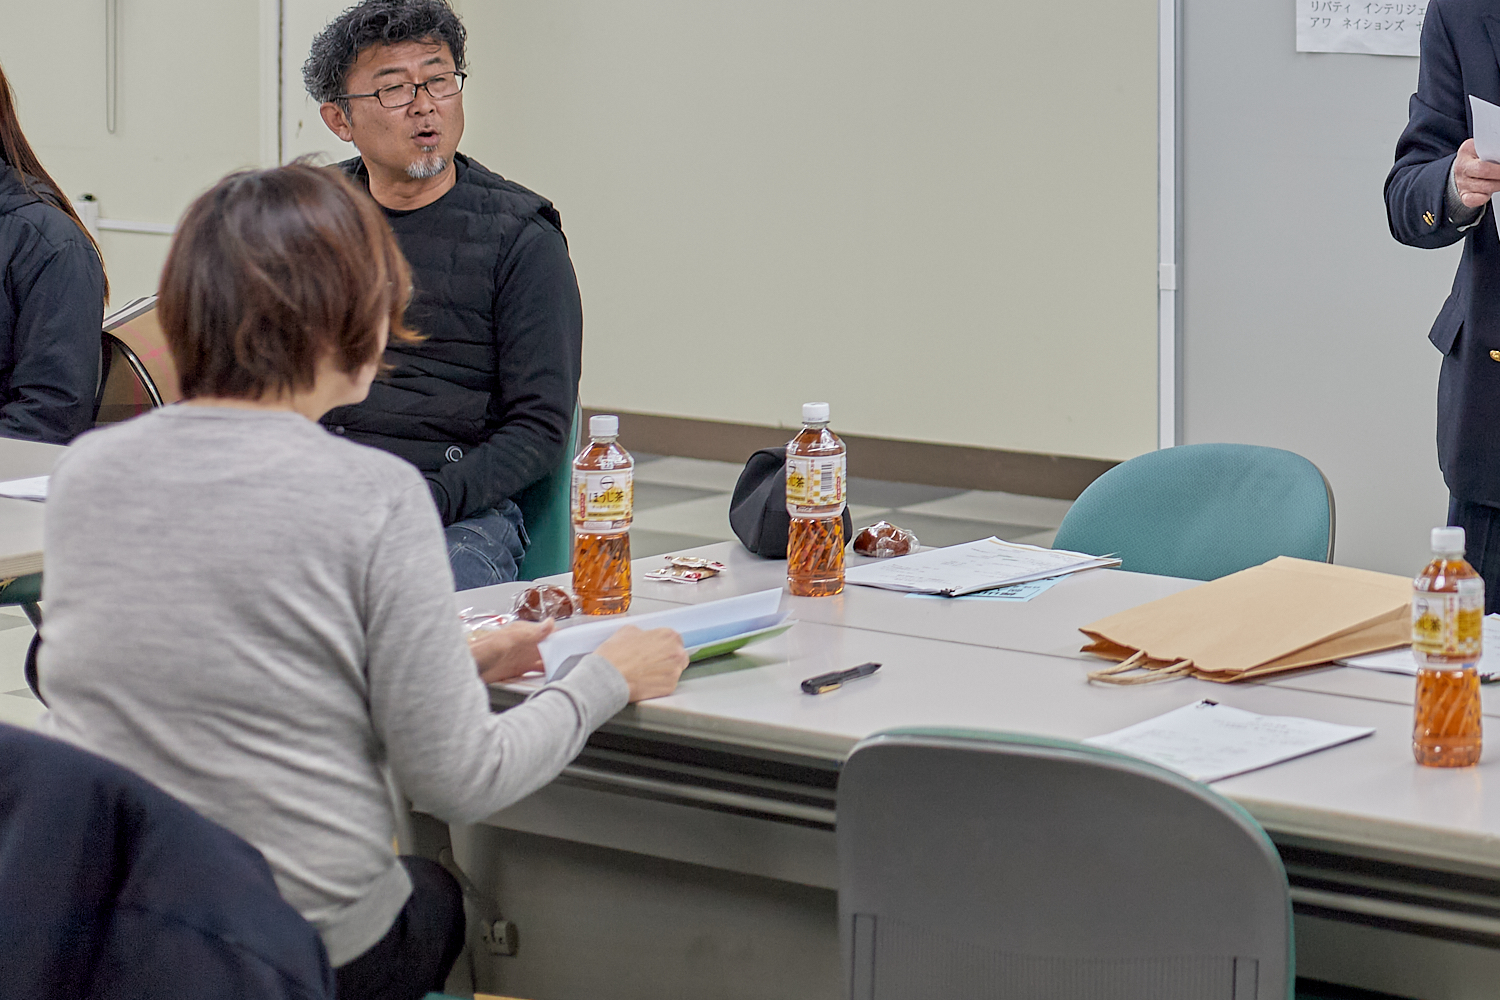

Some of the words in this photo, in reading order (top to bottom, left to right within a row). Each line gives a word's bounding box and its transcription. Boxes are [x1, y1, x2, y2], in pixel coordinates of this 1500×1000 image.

[1311, 0, 1351, 14] リバティ
[1310, 16, 1332, 29] アワ
[1342, 17, 1406, 32] ネイションズ
